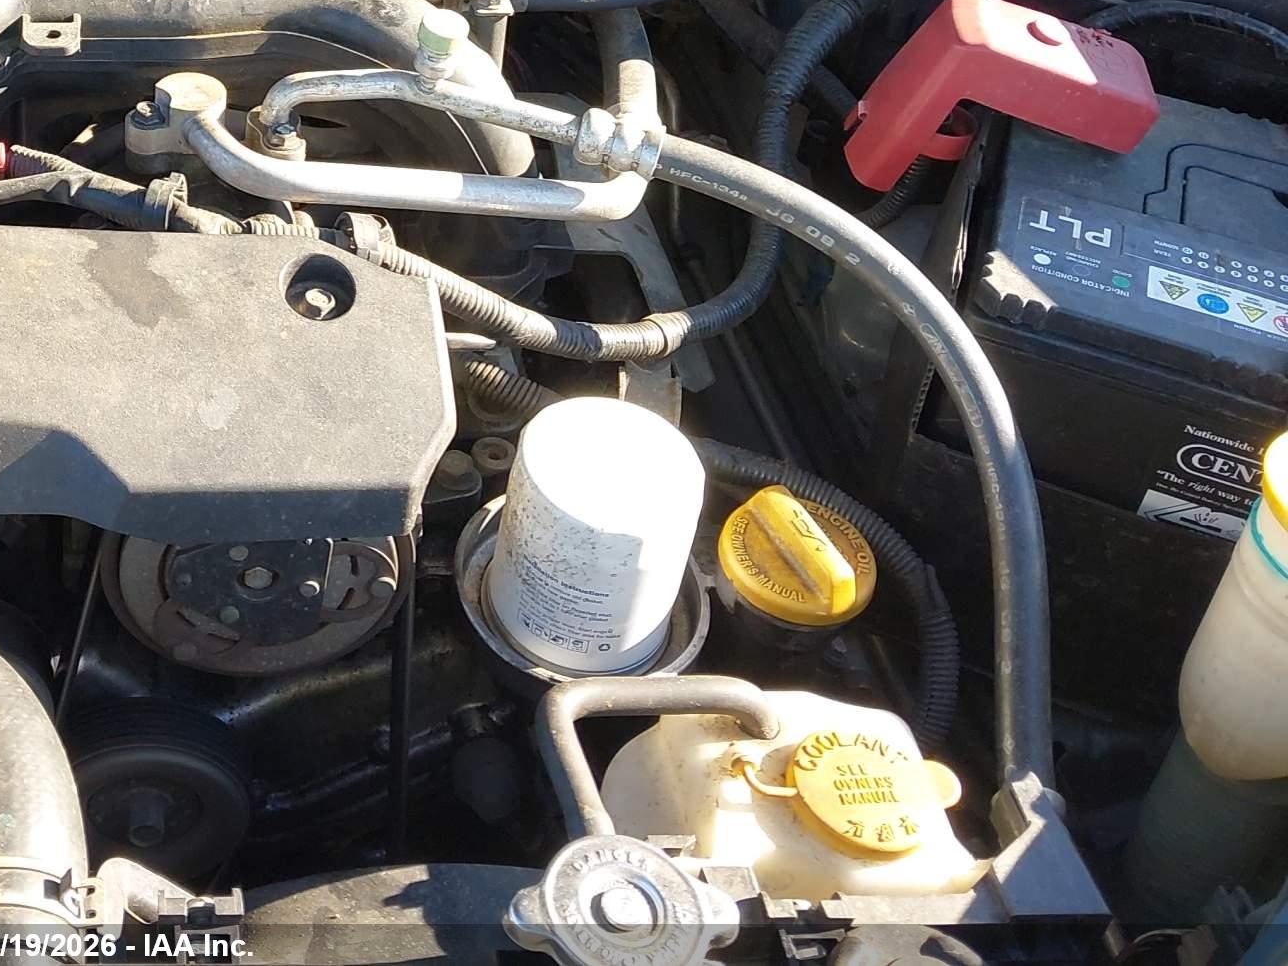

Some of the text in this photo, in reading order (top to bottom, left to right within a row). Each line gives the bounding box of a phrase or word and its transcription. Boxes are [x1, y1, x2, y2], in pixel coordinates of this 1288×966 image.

[765, 207, 796, 225] JG
[844, 251, 861, 266] 2
[1028, 208, 1112, 249] PLT
[1030, 264, 1131, 298] INDICATOR CONDITION
[1183, 424, 1255, 453] Nationwide
[1188, 480, 1216, 494] right
[1217, 490, 1242, 504] way
[806, 502, 864, 550] ENGINE
[855, 551, 872, 576] OIL
[730, 515, 807, 604] SEE OWNER'S MANUAL
[832, 776, 894, 792] OWNERS
[835, 763, 869, 777] SEE
[837, 789, 900, 806] MANUAL
